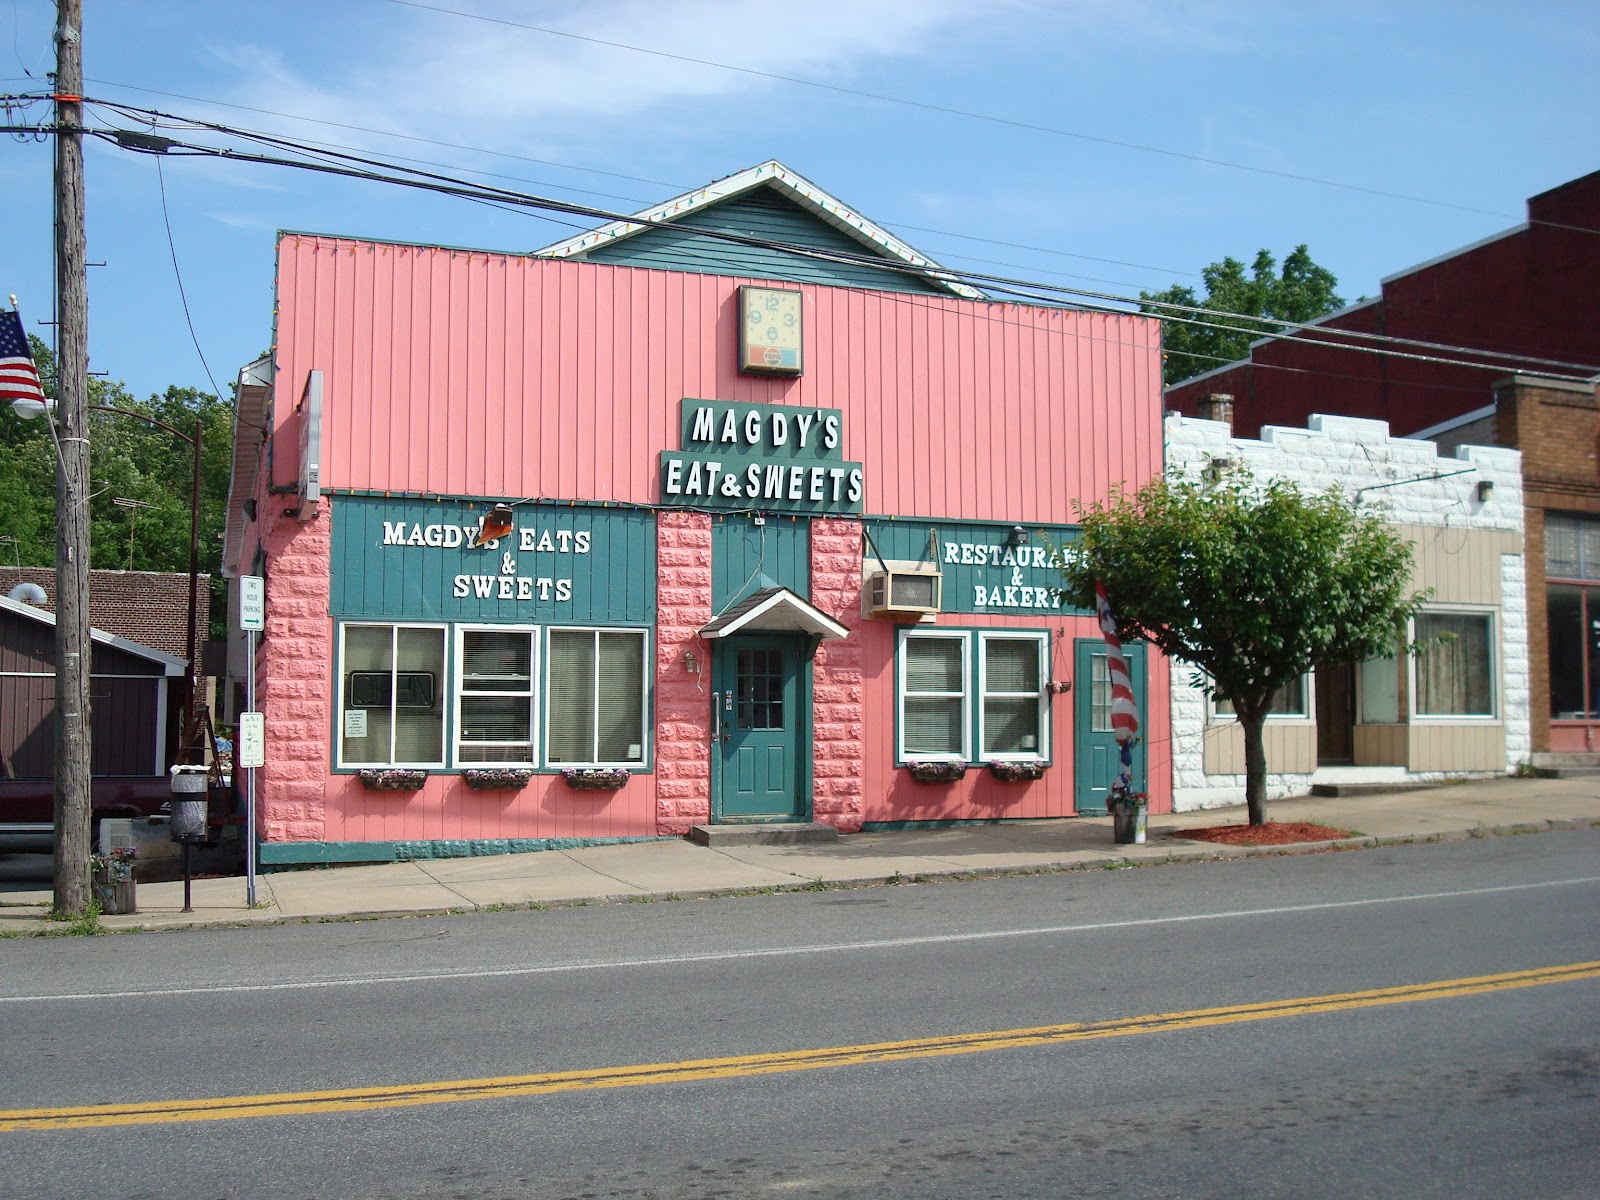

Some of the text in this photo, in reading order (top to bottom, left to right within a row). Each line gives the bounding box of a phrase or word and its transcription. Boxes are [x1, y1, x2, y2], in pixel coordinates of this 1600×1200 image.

[765, 297, 780, 311] 12
[750, 310, 762, 324] 9
[784, 313, 795, 327] 3
[767, 327, 778, 340] 6
[692, 407, 838, 449] MAGDY'S
[519, 528, 591, 553] EATS
[501, 551, 516, 575] &
[453, 574, 572, 601] SWEETS
[1011, 566, 1024, 587] &
[974, 586, 1063, 609] BAKERY
